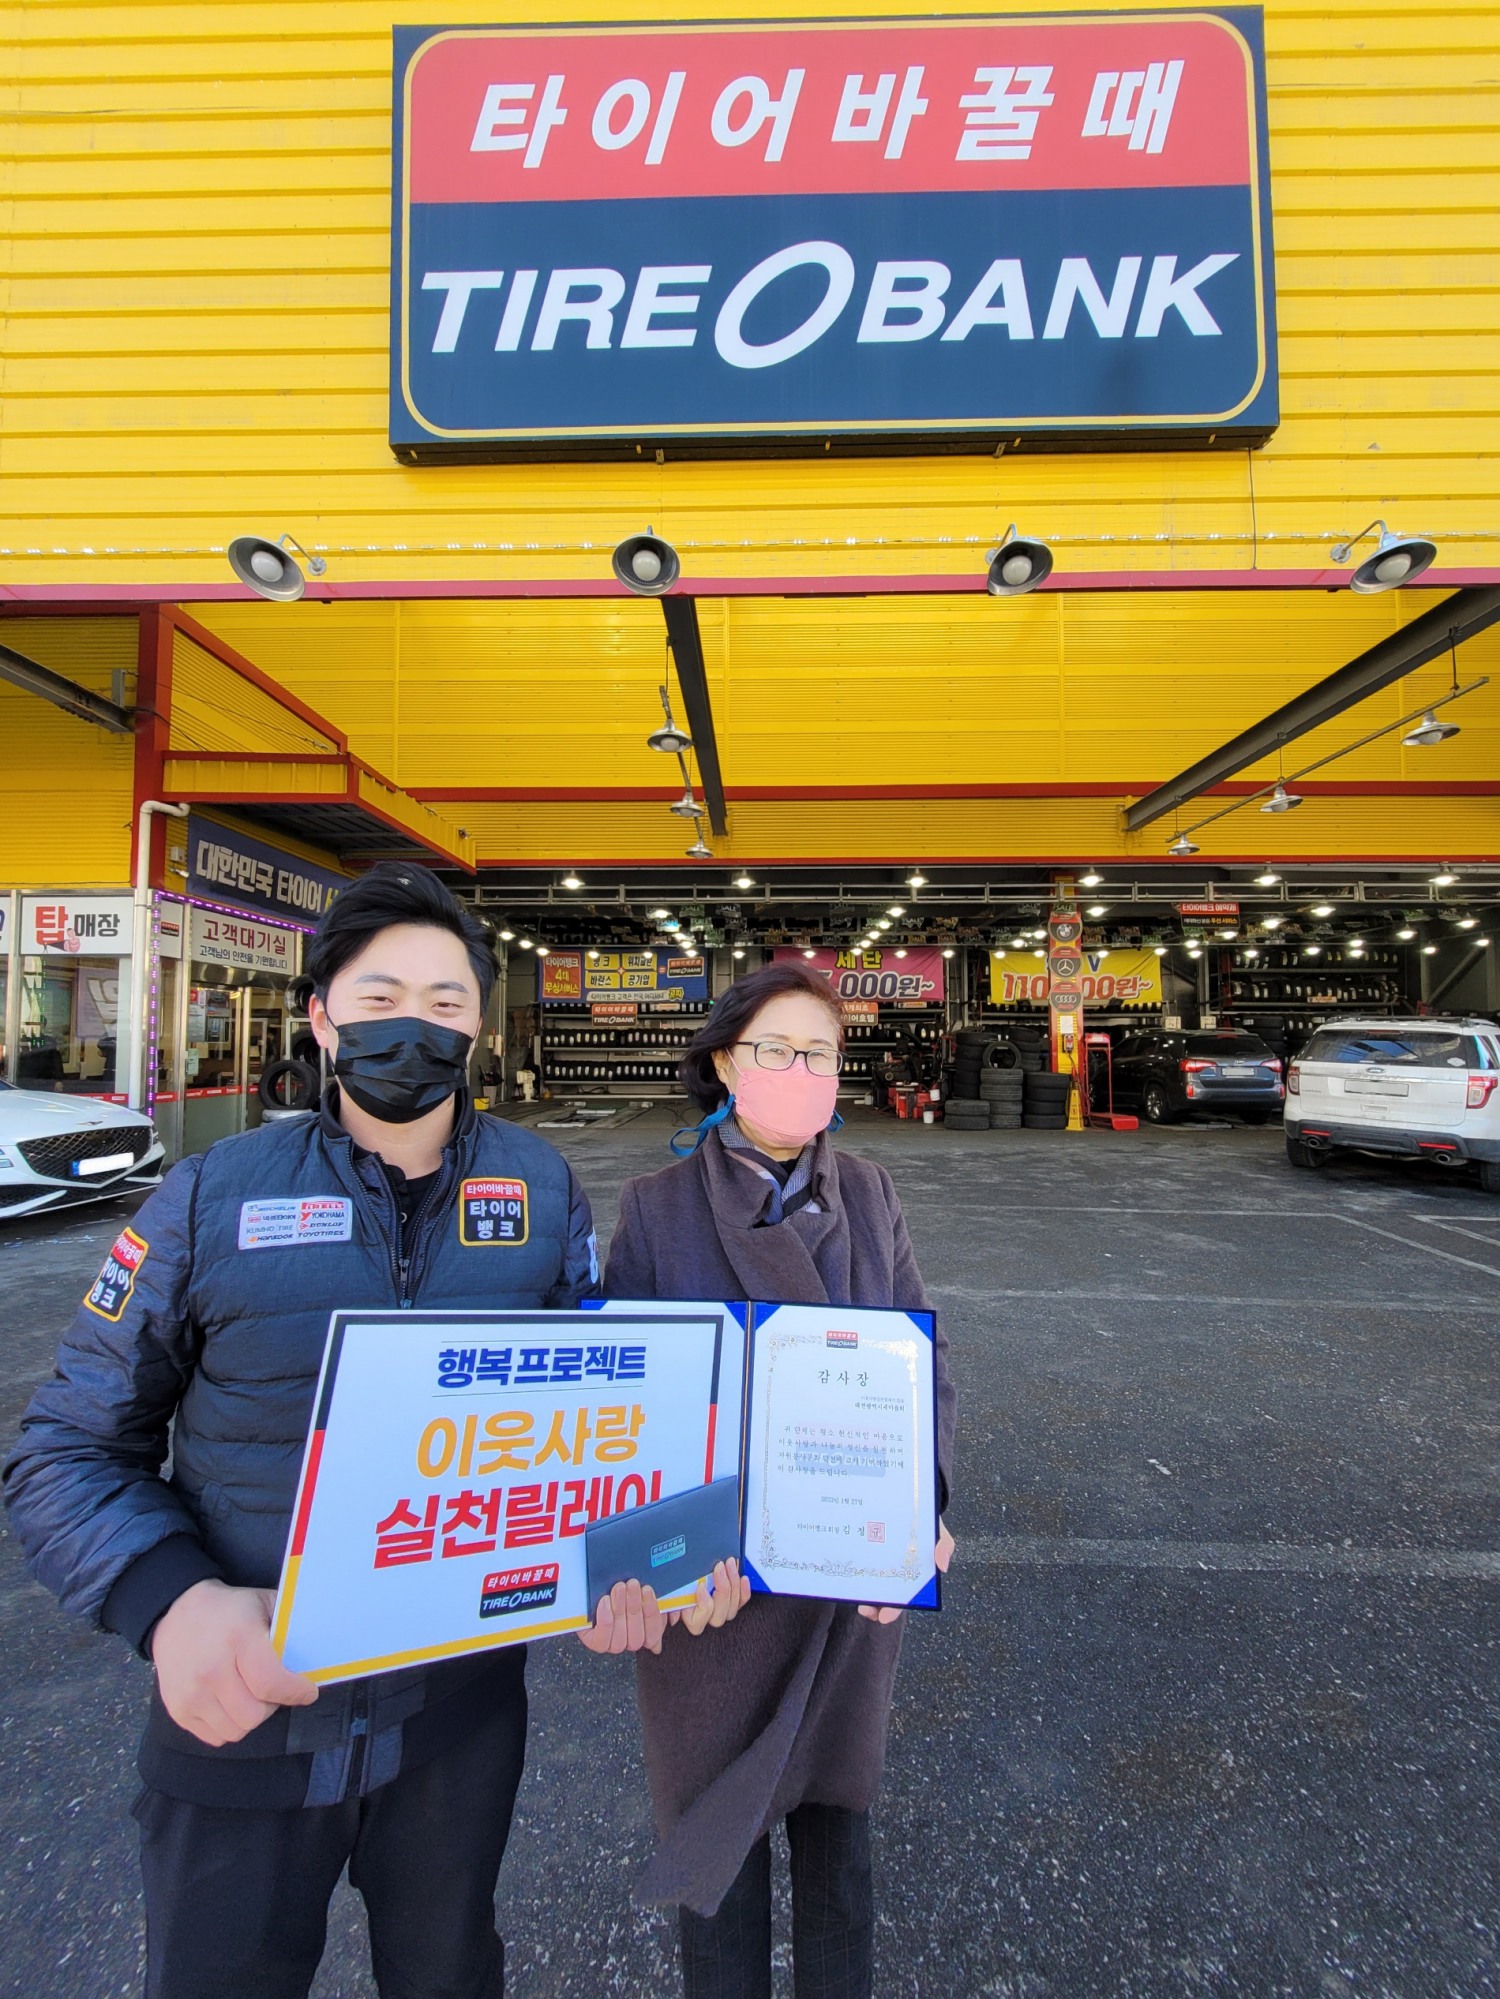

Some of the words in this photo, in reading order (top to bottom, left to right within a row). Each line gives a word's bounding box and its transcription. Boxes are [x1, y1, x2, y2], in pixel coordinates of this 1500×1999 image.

[196, 840, 274, 898] 대한민국
[277, 870, 322, 913] 타이어
[1055, 904, 1074, 912] SALE
[36, 906, 69, 945] 탑
[75, 914, 121, 937] 매장
[203, 919, 286, 955] 고객대기실
[200, 945, 230, 960] 고객님의
[546, 957, 579, 968] 타이어뱅크
[555, 968, 570, 982] 4대
[590, 974, 612, 986] 바란스
[628, 974, 650, 986] 공기압
[545, 982, 580, 994] 무상서비스
[466, 1183, 522, 1196] 타이어바꿀때
[312, 1211, 345, 1219] YOKOHAMA
[469, 1200, 522, 1218] 타이어
[416, 1404, 647, 1478] 이웃사랑
